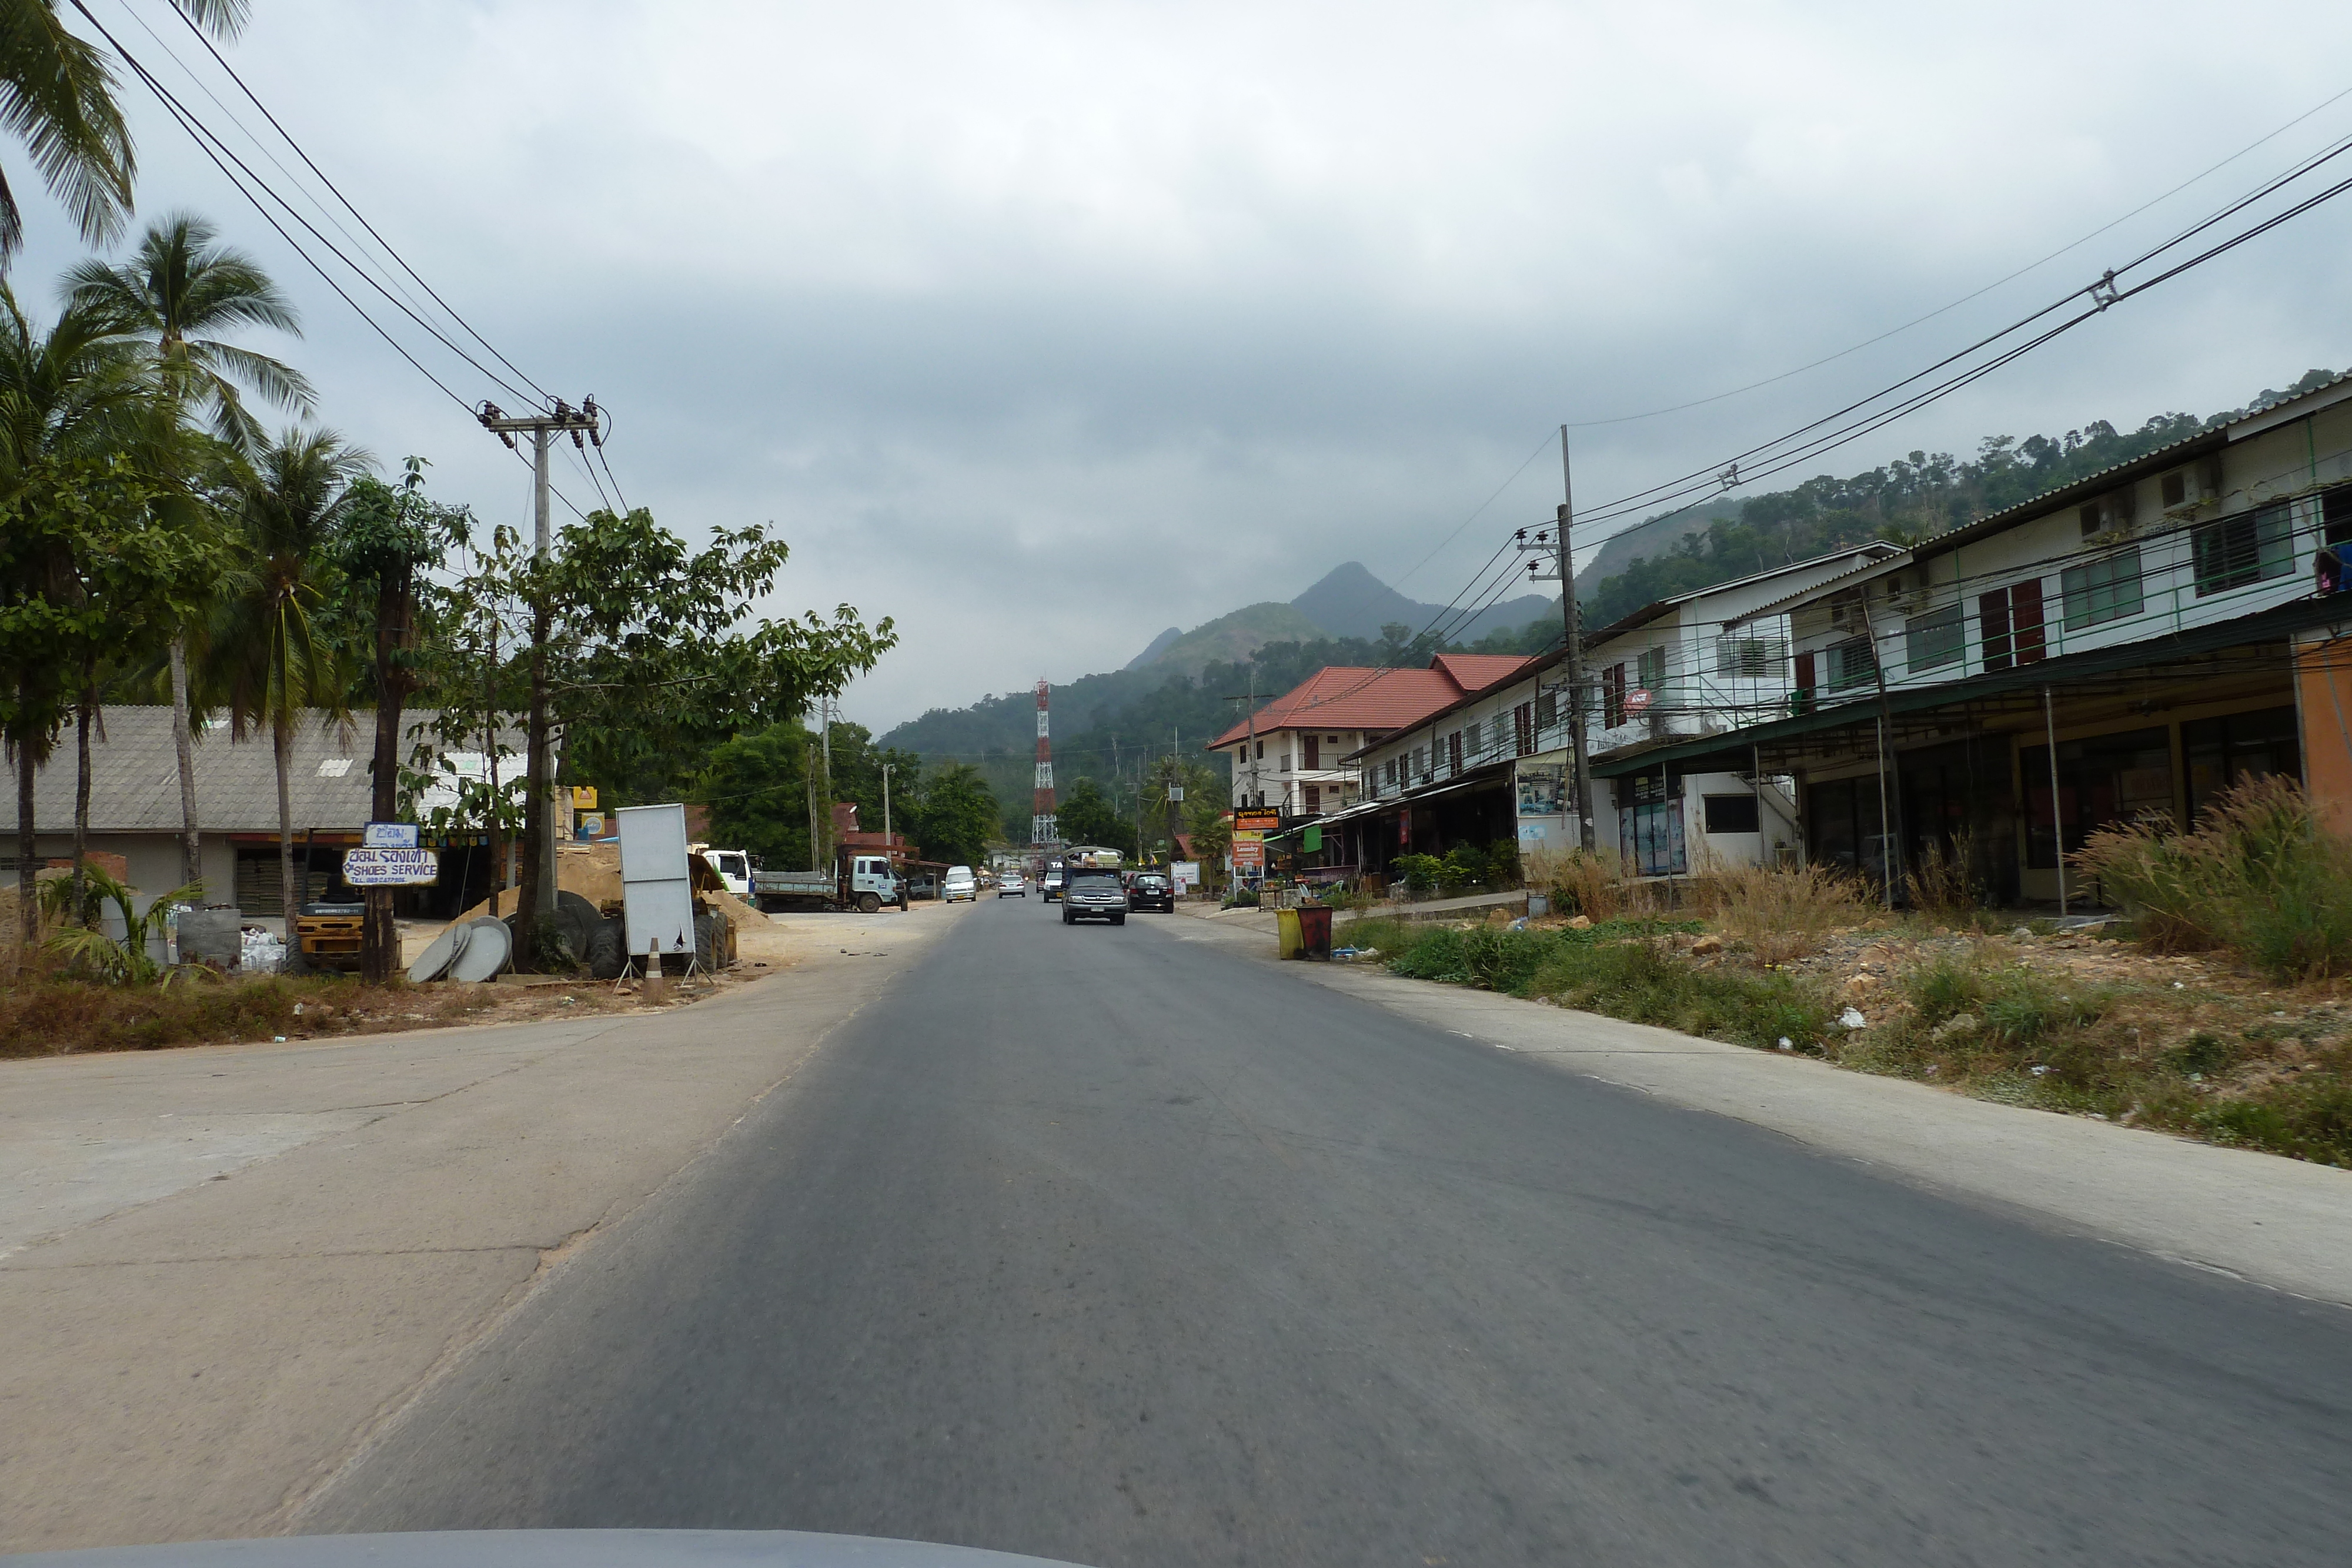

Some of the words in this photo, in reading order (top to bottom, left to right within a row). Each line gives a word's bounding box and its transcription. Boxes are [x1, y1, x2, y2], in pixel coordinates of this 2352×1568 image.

[379, 848, 427, 863] รองเท้า
[353, 865, 387, 876] SHOES
